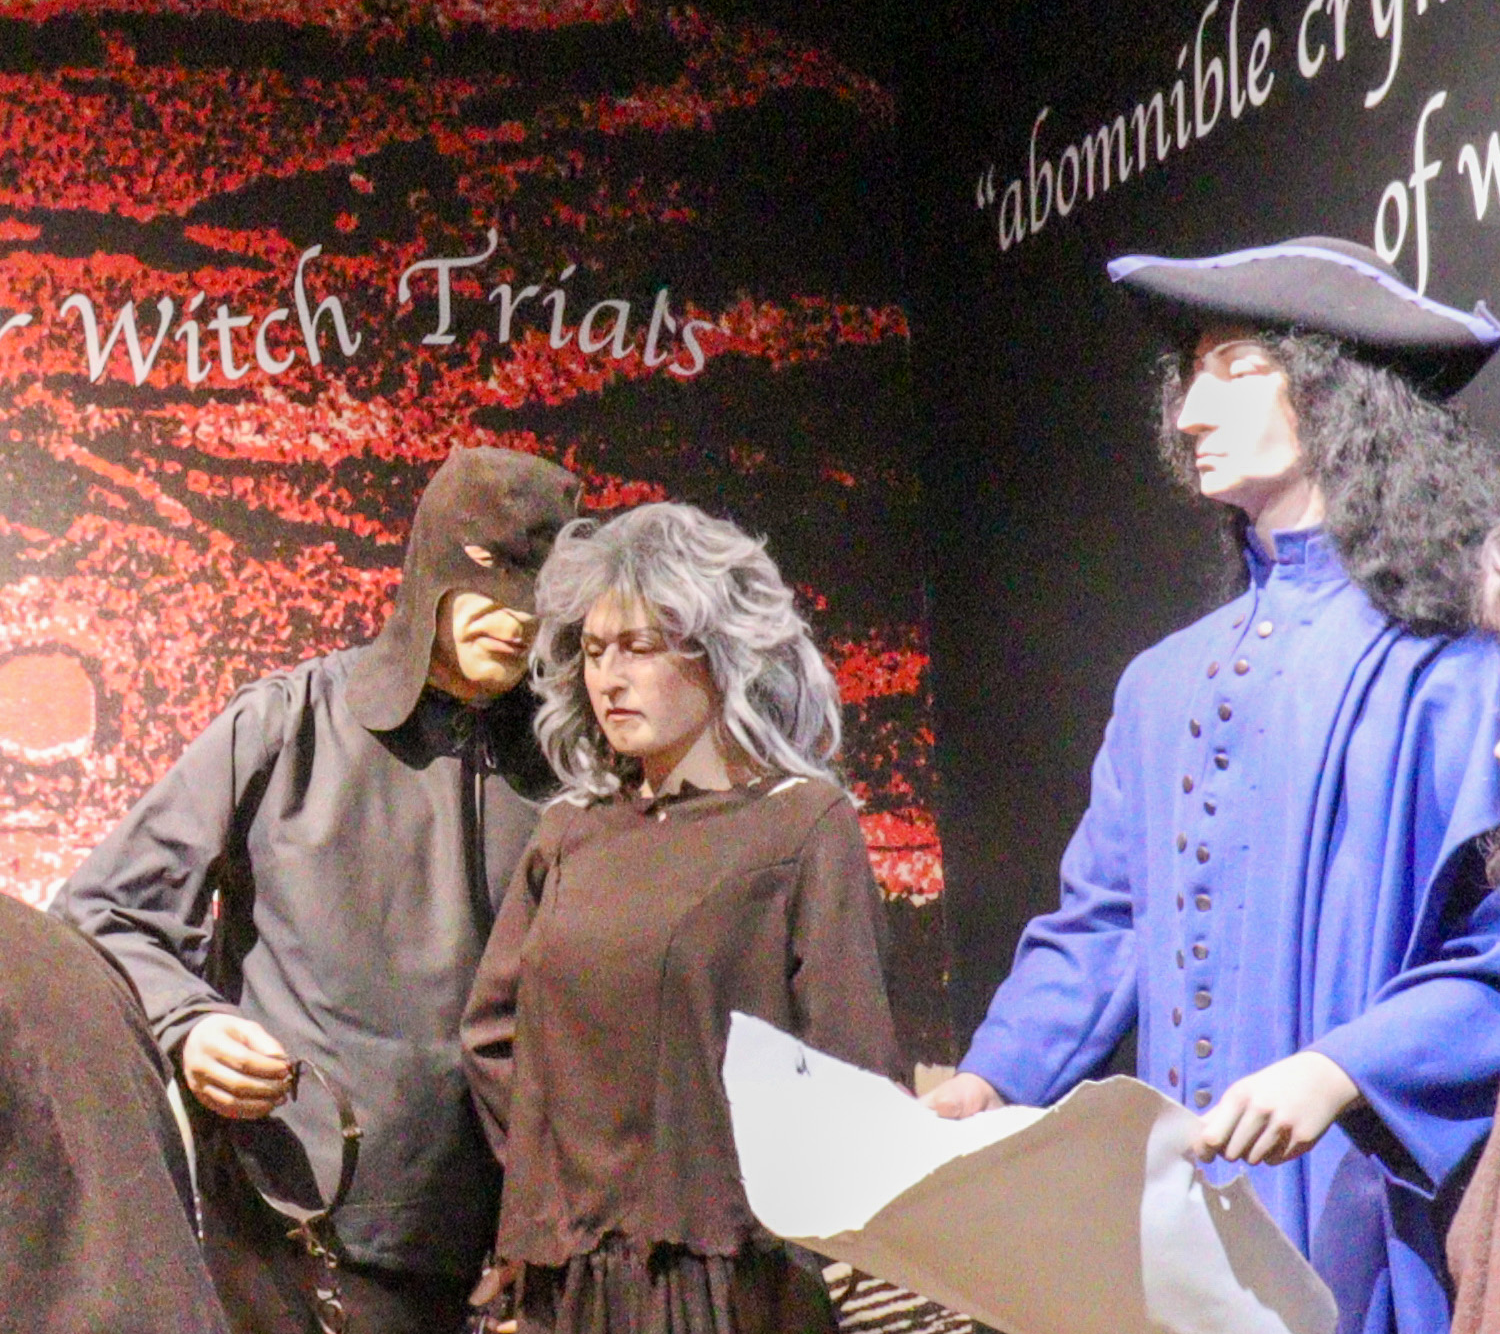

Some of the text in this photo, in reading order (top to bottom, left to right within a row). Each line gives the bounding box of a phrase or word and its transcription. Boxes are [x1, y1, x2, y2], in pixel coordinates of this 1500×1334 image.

[1373, 91, 1447, 299] of
[59, 244, 363, 389] Witch
[398, 227, 724, 377] Trials
